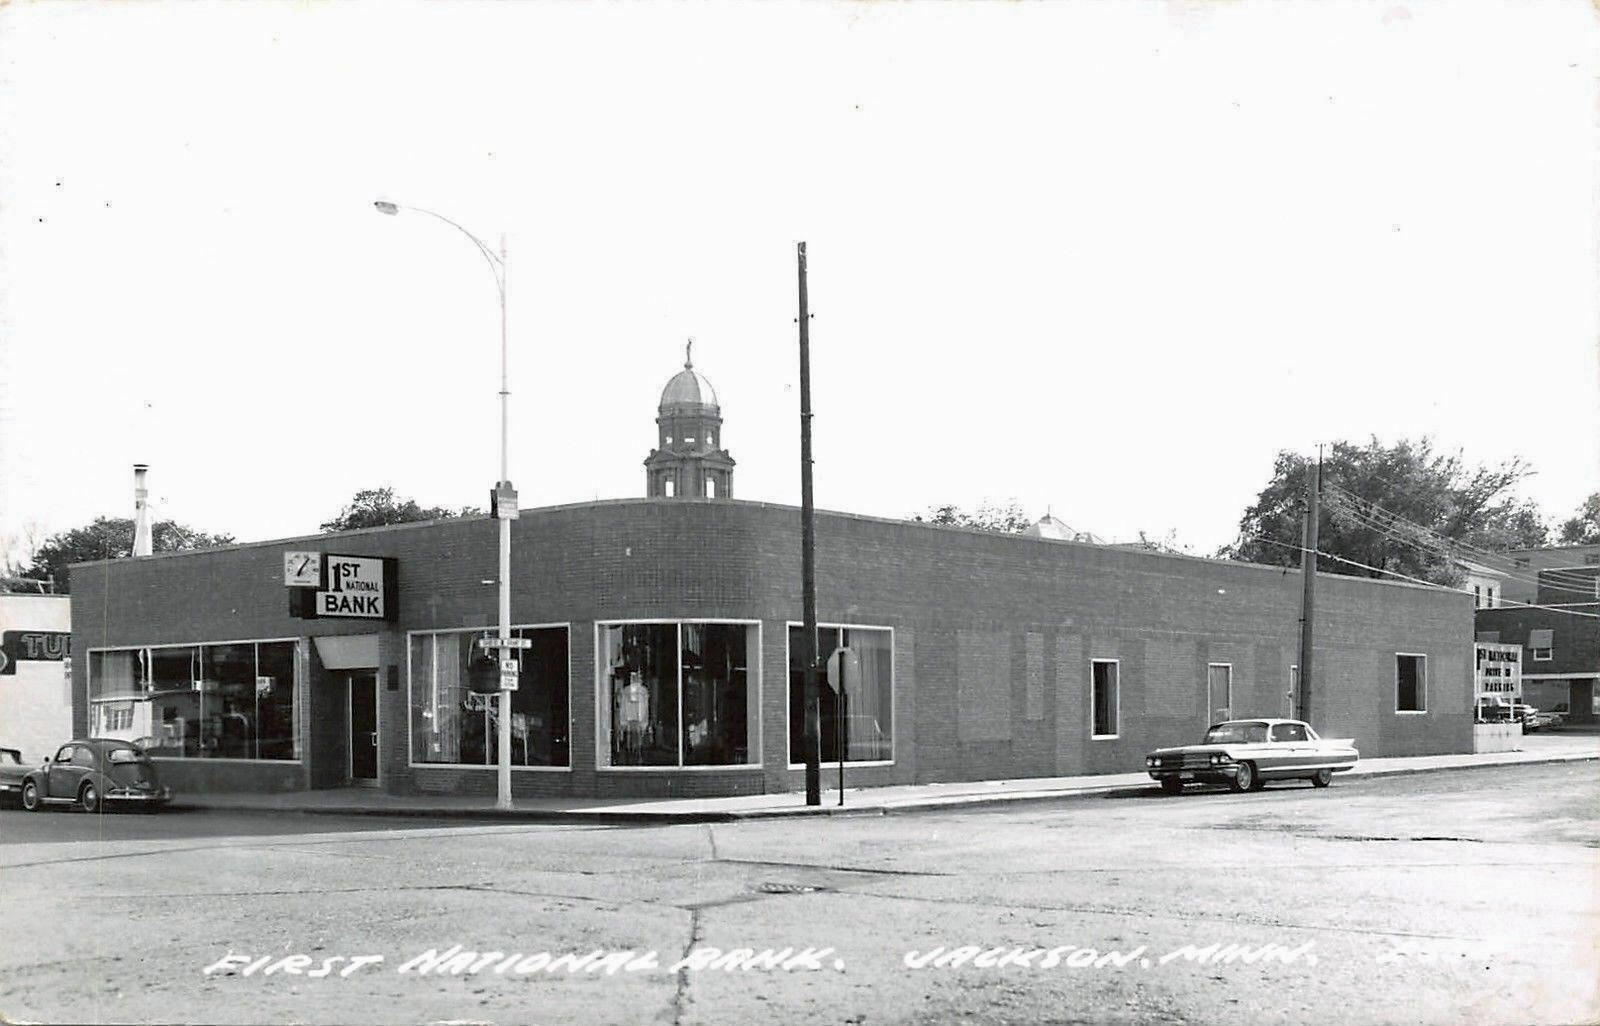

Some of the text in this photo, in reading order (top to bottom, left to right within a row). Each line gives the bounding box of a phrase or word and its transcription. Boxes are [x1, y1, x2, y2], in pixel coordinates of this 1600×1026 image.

[332, 563, 360, 592] 1ST
[345, 581, 379, 592] NATIONAL
[325, 594, 379, 614] BANK
